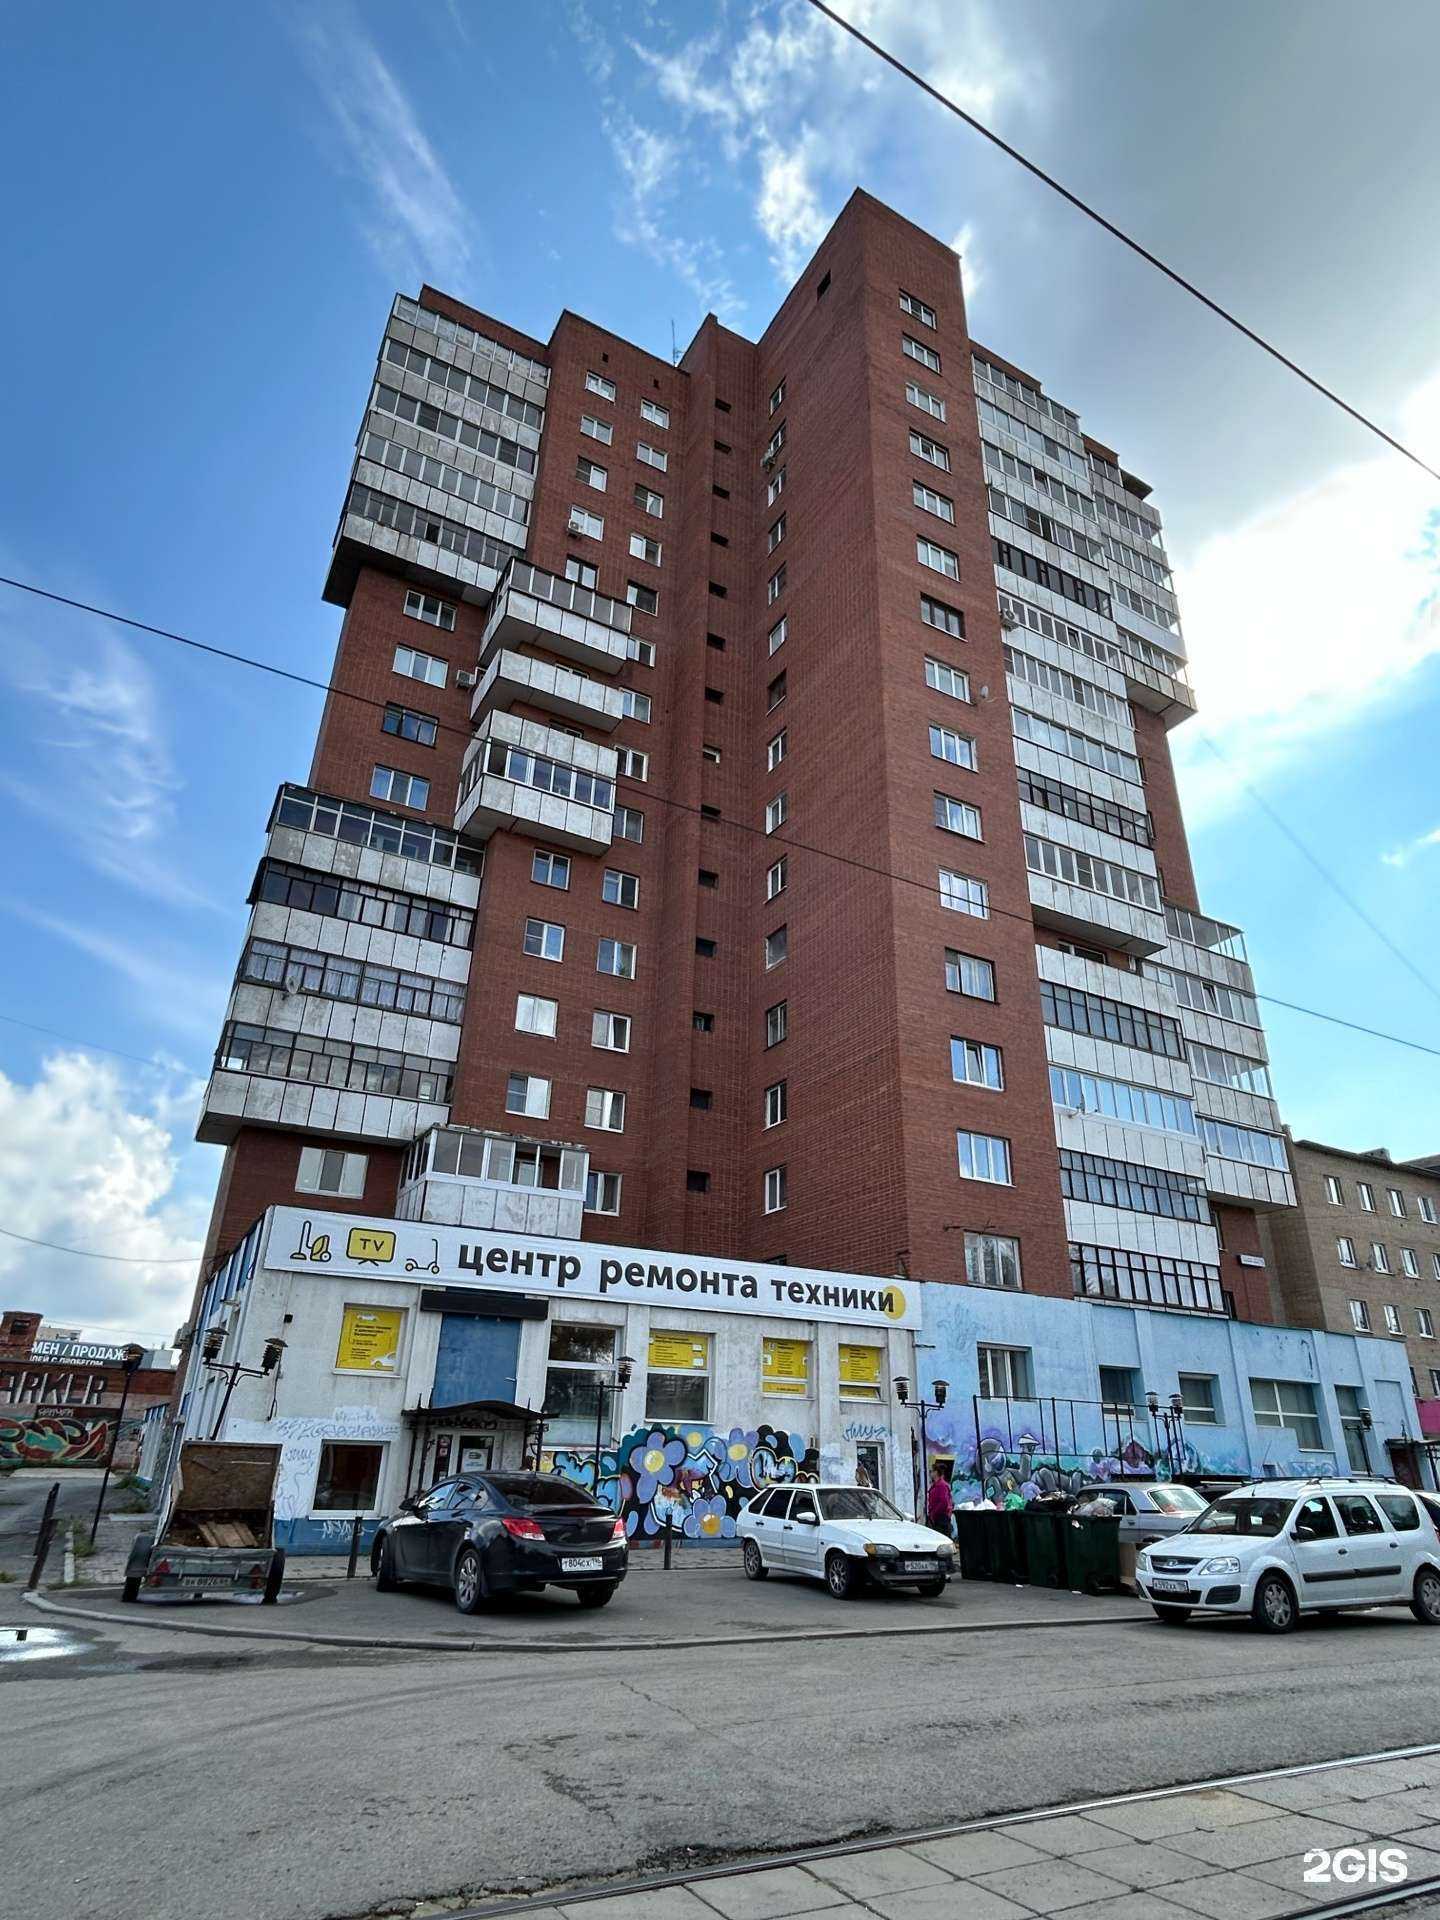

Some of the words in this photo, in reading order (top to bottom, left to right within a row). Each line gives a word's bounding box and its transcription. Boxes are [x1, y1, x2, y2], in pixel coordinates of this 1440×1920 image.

[359, 1238, 386, 1252] TV
[458, 1243, 582, 1288] центр
[599, 1258, 759, 1299] ремонта
[770, 1278, 895, 1313] техники
